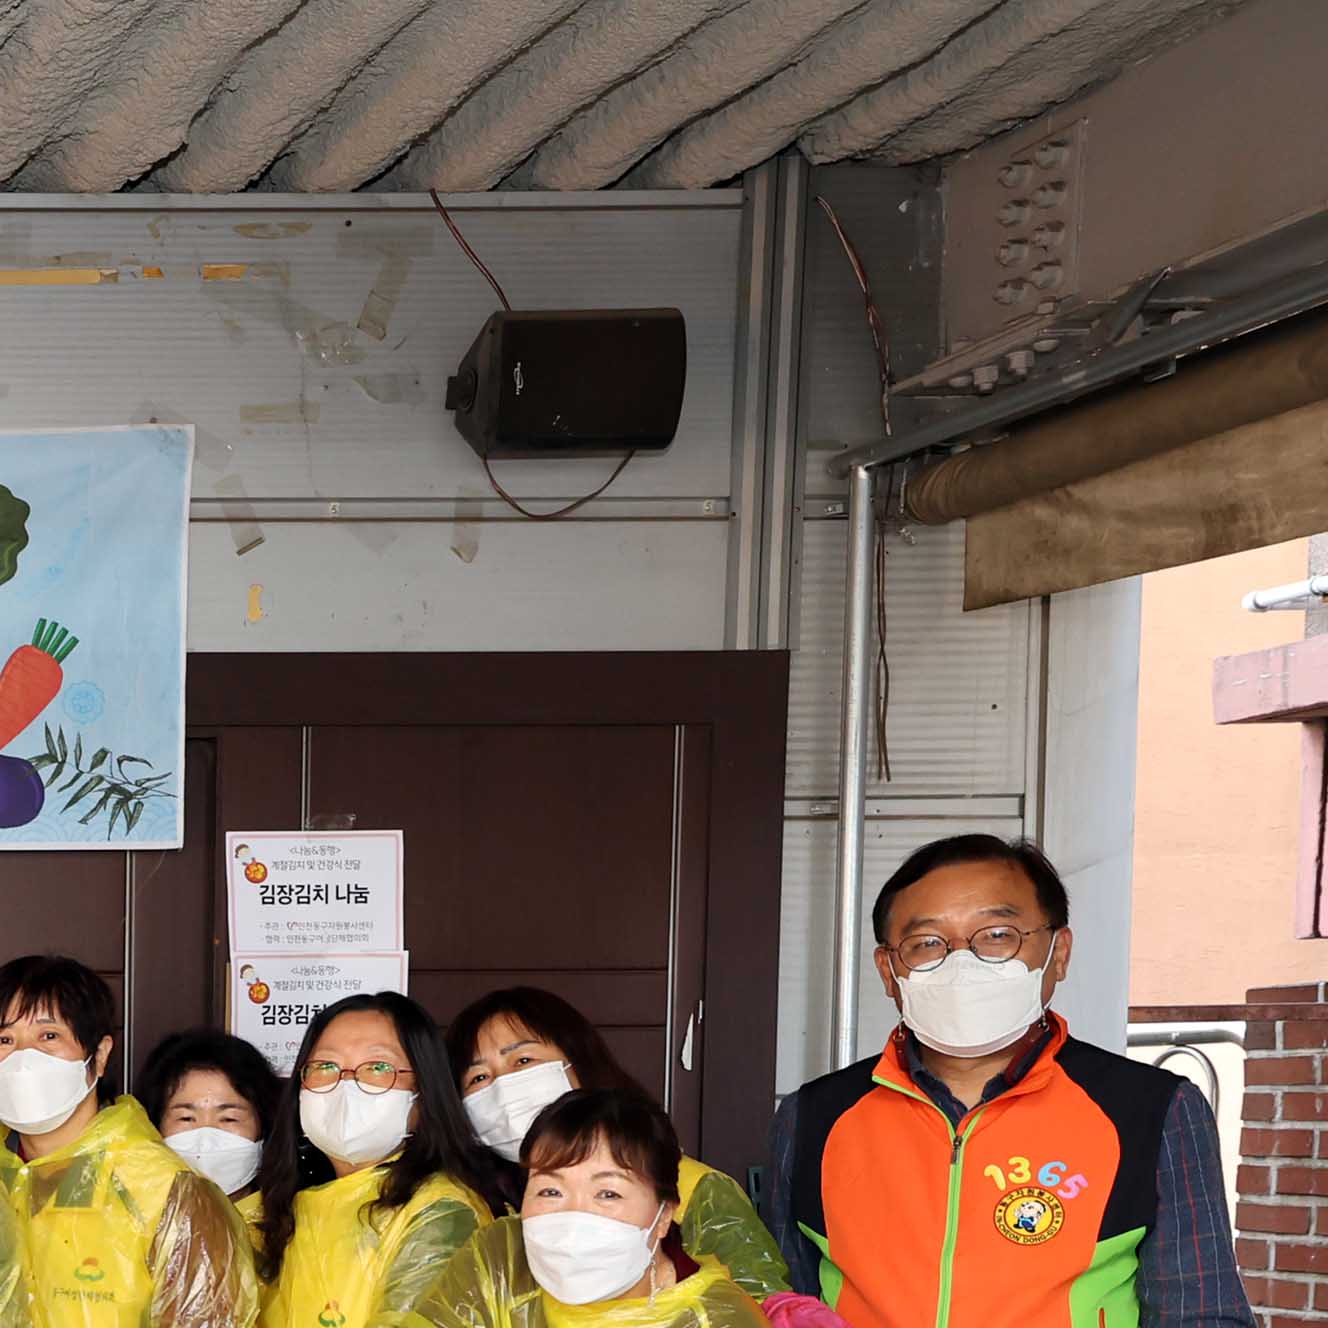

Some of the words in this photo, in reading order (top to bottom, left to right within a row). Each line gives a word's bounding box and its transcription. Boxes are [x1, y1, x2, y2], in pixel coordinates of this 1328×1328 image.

[258, 883, 330, 905] 김장김치
[335, 882, 370, 905] 나눔
[984, 1156, 1088, 1199] 1365
